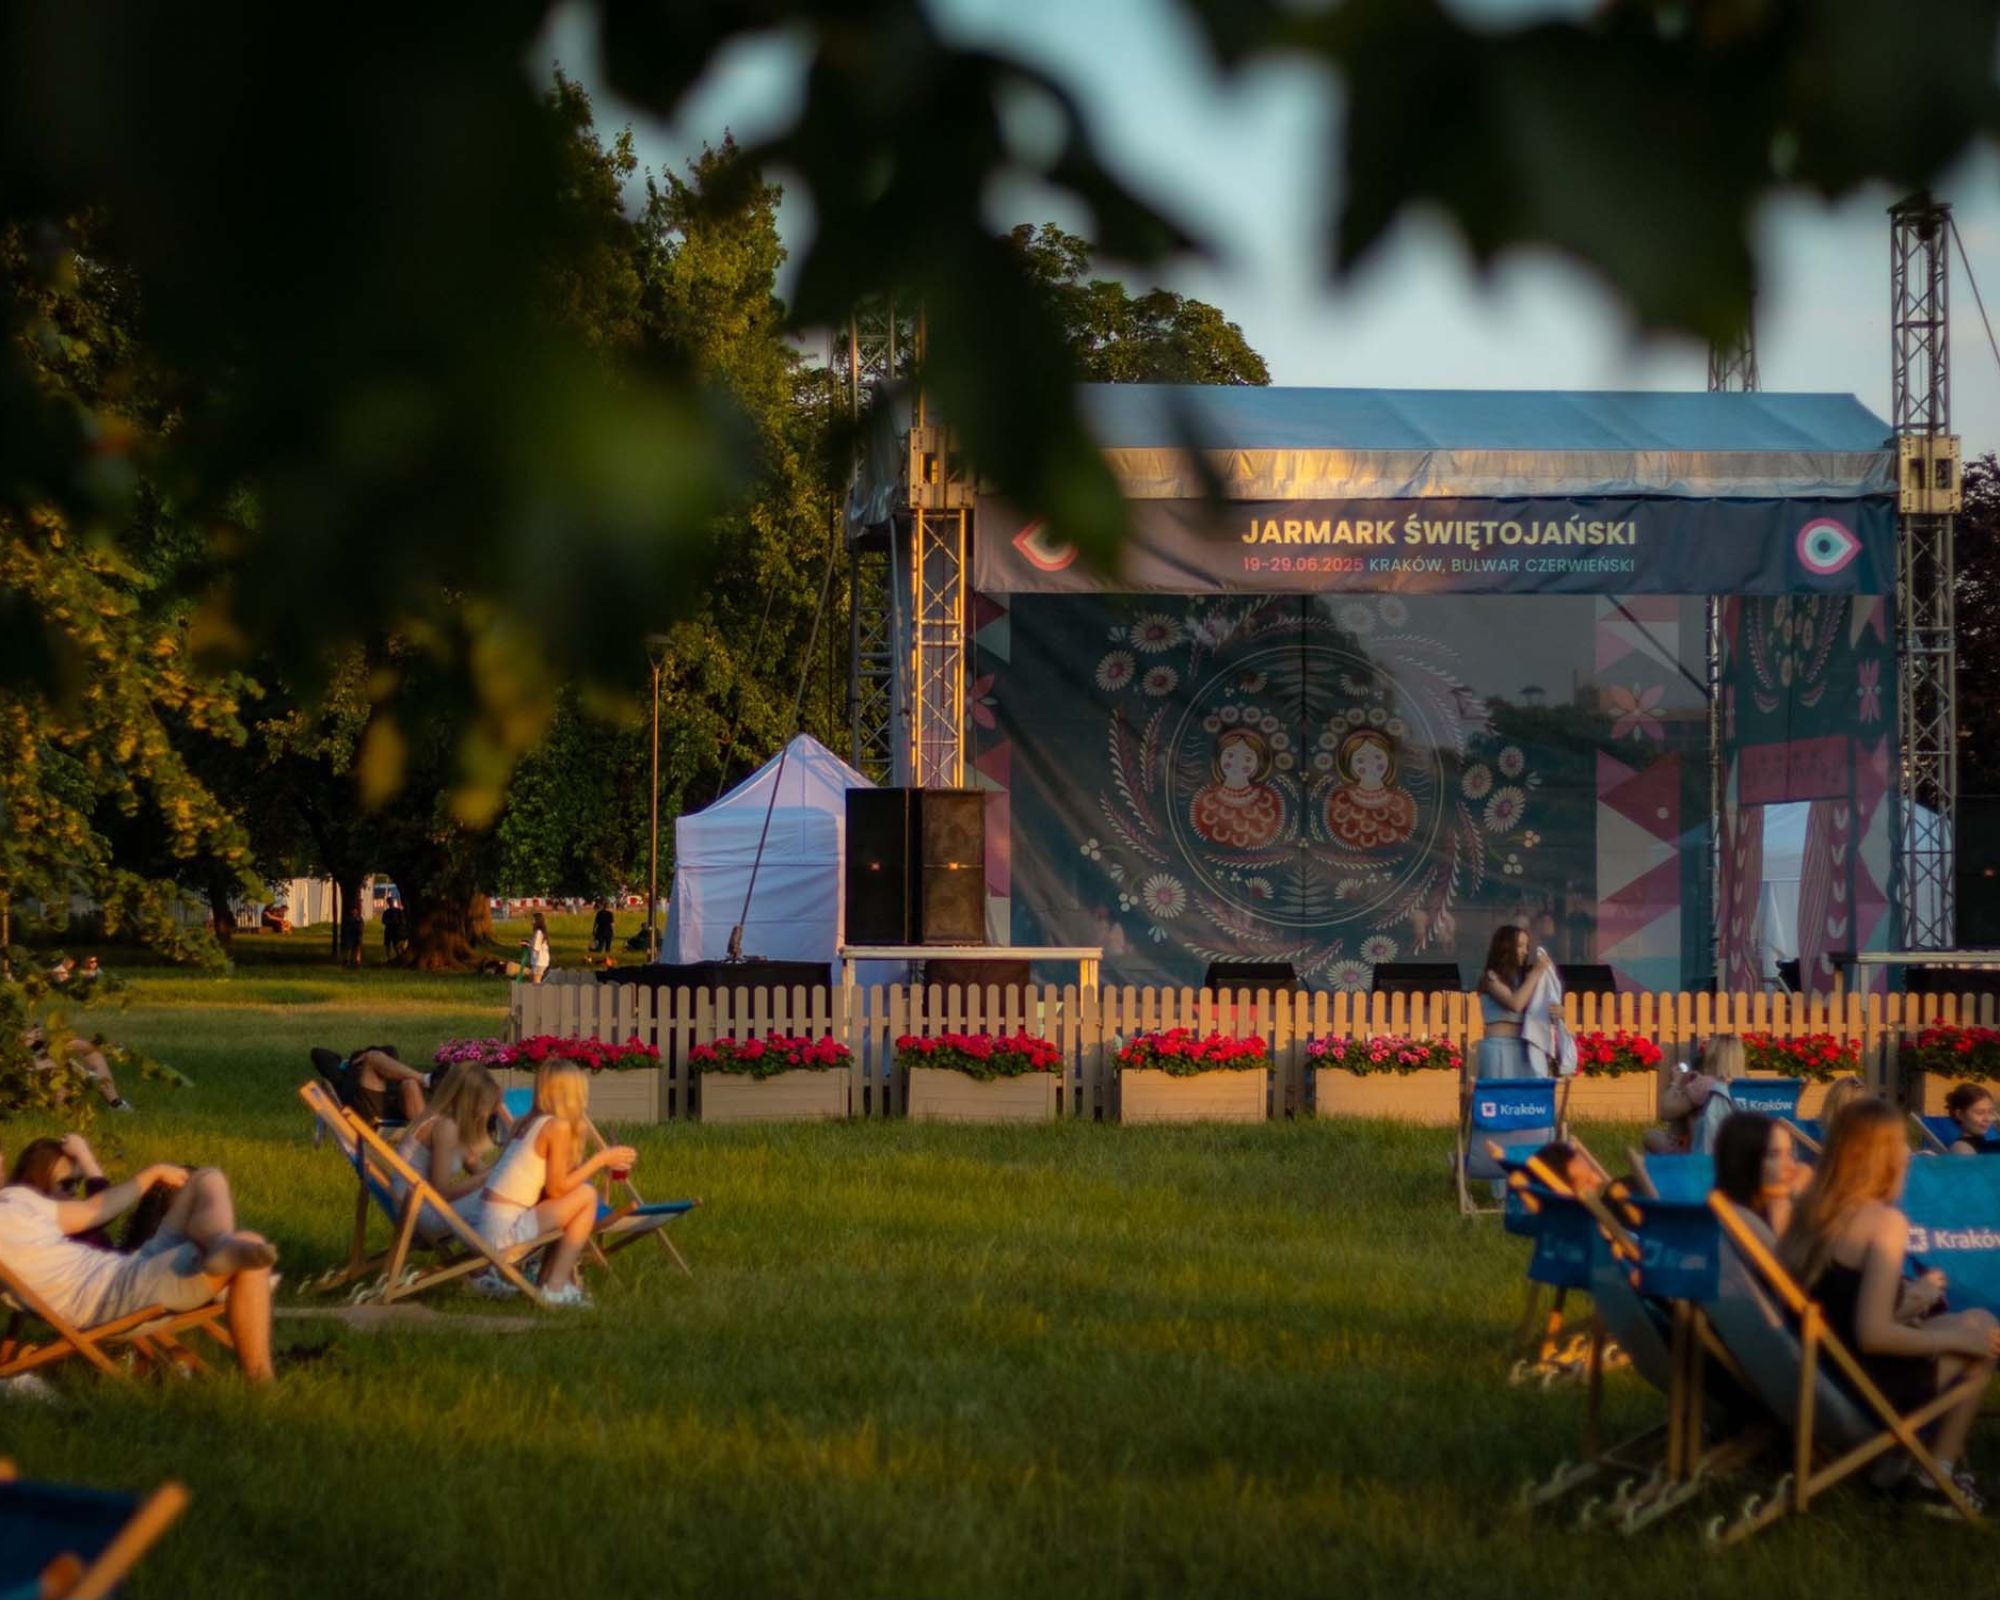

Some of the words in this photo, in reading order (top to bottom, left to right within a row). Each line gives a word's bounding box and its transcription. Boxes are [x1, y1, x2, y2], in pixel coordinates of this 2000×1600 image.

[1241, 520, 1396, 545] JARMARK
[1404, 513, 1637, 551] ŚWIĘTOJAŃSKI
[1243, 557, 1364, 572] 19-29.06.2025
[1369, 553, 1445, 575] KRAKÓW,
[1451, 558, 1519, 573] BULWAR
[1525, 554, 1635, 573] CZERWIEŃSKI
[1500, 1102, 1547, 1116] Kraków
[1749, 1097, 1793, 1111] Kraków
